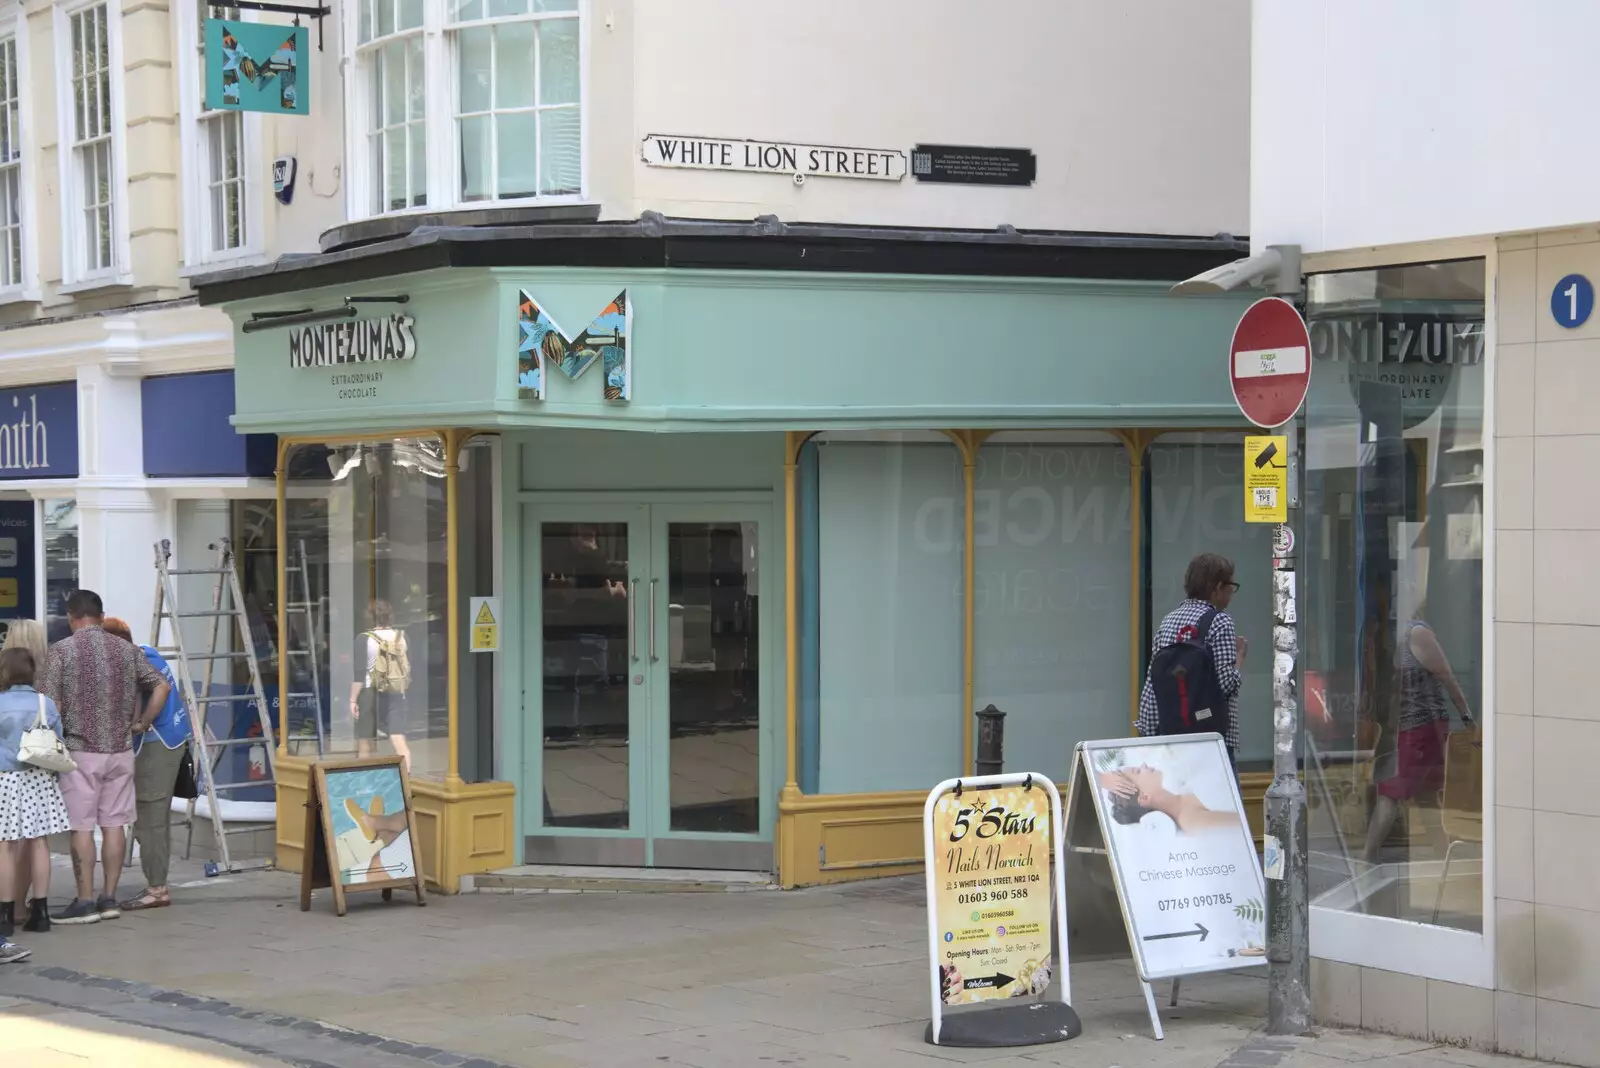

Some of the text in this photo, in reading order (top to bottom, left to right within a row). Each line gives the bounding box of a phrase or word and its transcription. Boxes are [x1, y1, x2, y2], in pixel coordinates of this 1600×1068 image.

[222, 25, 297, 109] M
[656, 139, 895, 176] WHITE LION STREET
[1563, 283, 1577, 320] 1
[289, 313, 416, 368] MONTEZUMA'S
[518, 287, 633, 401] M
[331, 372, 384, 386] EXTRAORDINARY
[338, 387, 377, 399] CHOCOLATE
[949, 807, 1036, 842] 5 Stars
[946, 844, 1034, 874] Nails Norwich
[1168, 850, 1199, 862] Anna
[953, 881, 958, 889] 5
[959, 880, 977, 888] WHITE
[978, 879, 992, 887] LION
[1014, 875, 1026, 884] NR2
[1028, 874, 1040, 882] 1QA
[1138, 863, 1236, 883] Chinese Massage
[958, 888, 1028, 904] 01603 960 588
[1158, 892, 1233, 912] 07769 090785
[946, 950, 971, 960] Opening
[991, 956, 1008, 966] Closed
[966, 979, 993, 989] Welcome
